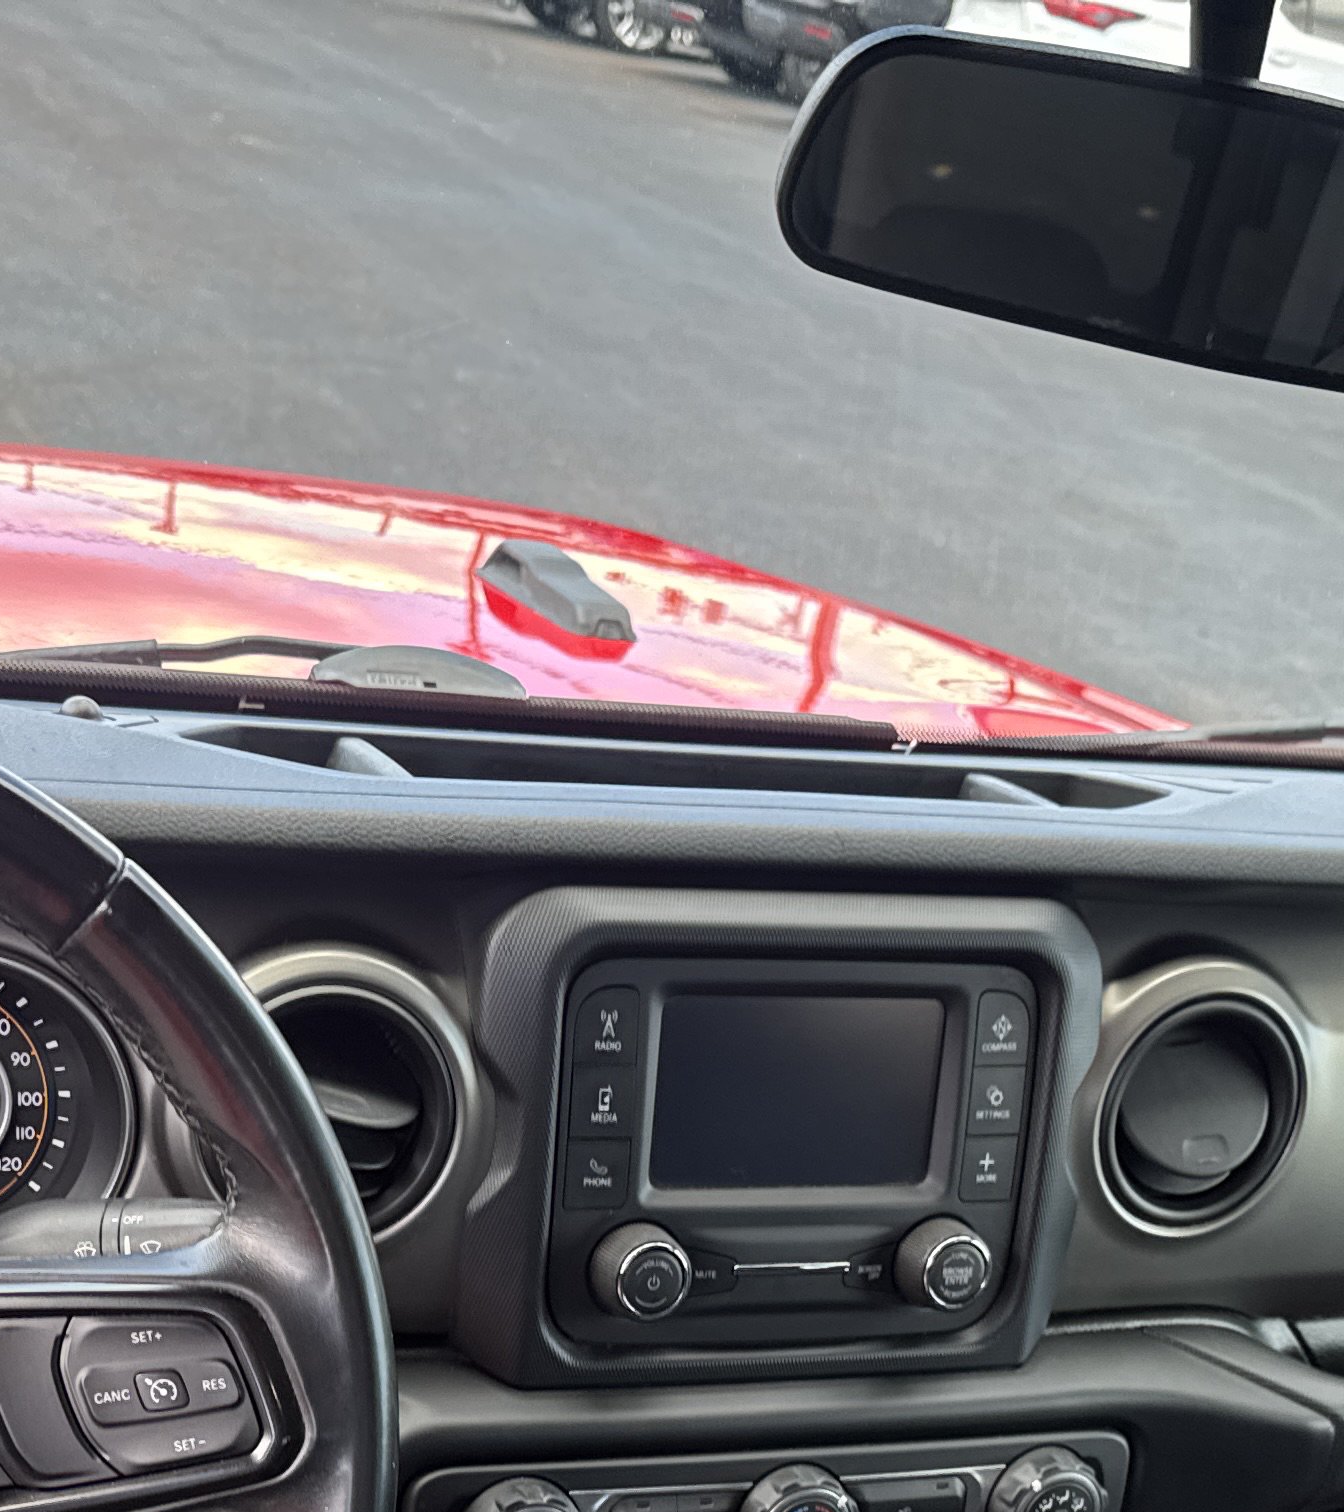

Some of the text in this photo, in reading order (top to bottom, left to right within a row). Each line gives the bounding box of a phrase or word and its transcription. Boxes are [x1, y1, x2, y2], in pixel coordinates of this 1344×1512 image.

[594, 1040, 622, 1051] RADIO
[982, 1042, 1017, 1053] COMPASS
[9, 1051, 32, 1068] 90
[16, 1091, 44, 1108] 100
[590, 1112, 618, 1124] MEDIA
[975, 1109, 1010, 1120] SETTINGS
[15, 1126, 36, 1142] 110
[583, 1176, 612, 1188] PHONE
[976, 1174, 997, 1183] MORE
[123, 1215, 144, 1226] OFF
[696, 1270, 716, 1280] MUTE
[202, 1378, 227, 1392] RES
[93, 1388, 131, 1404] CANC
